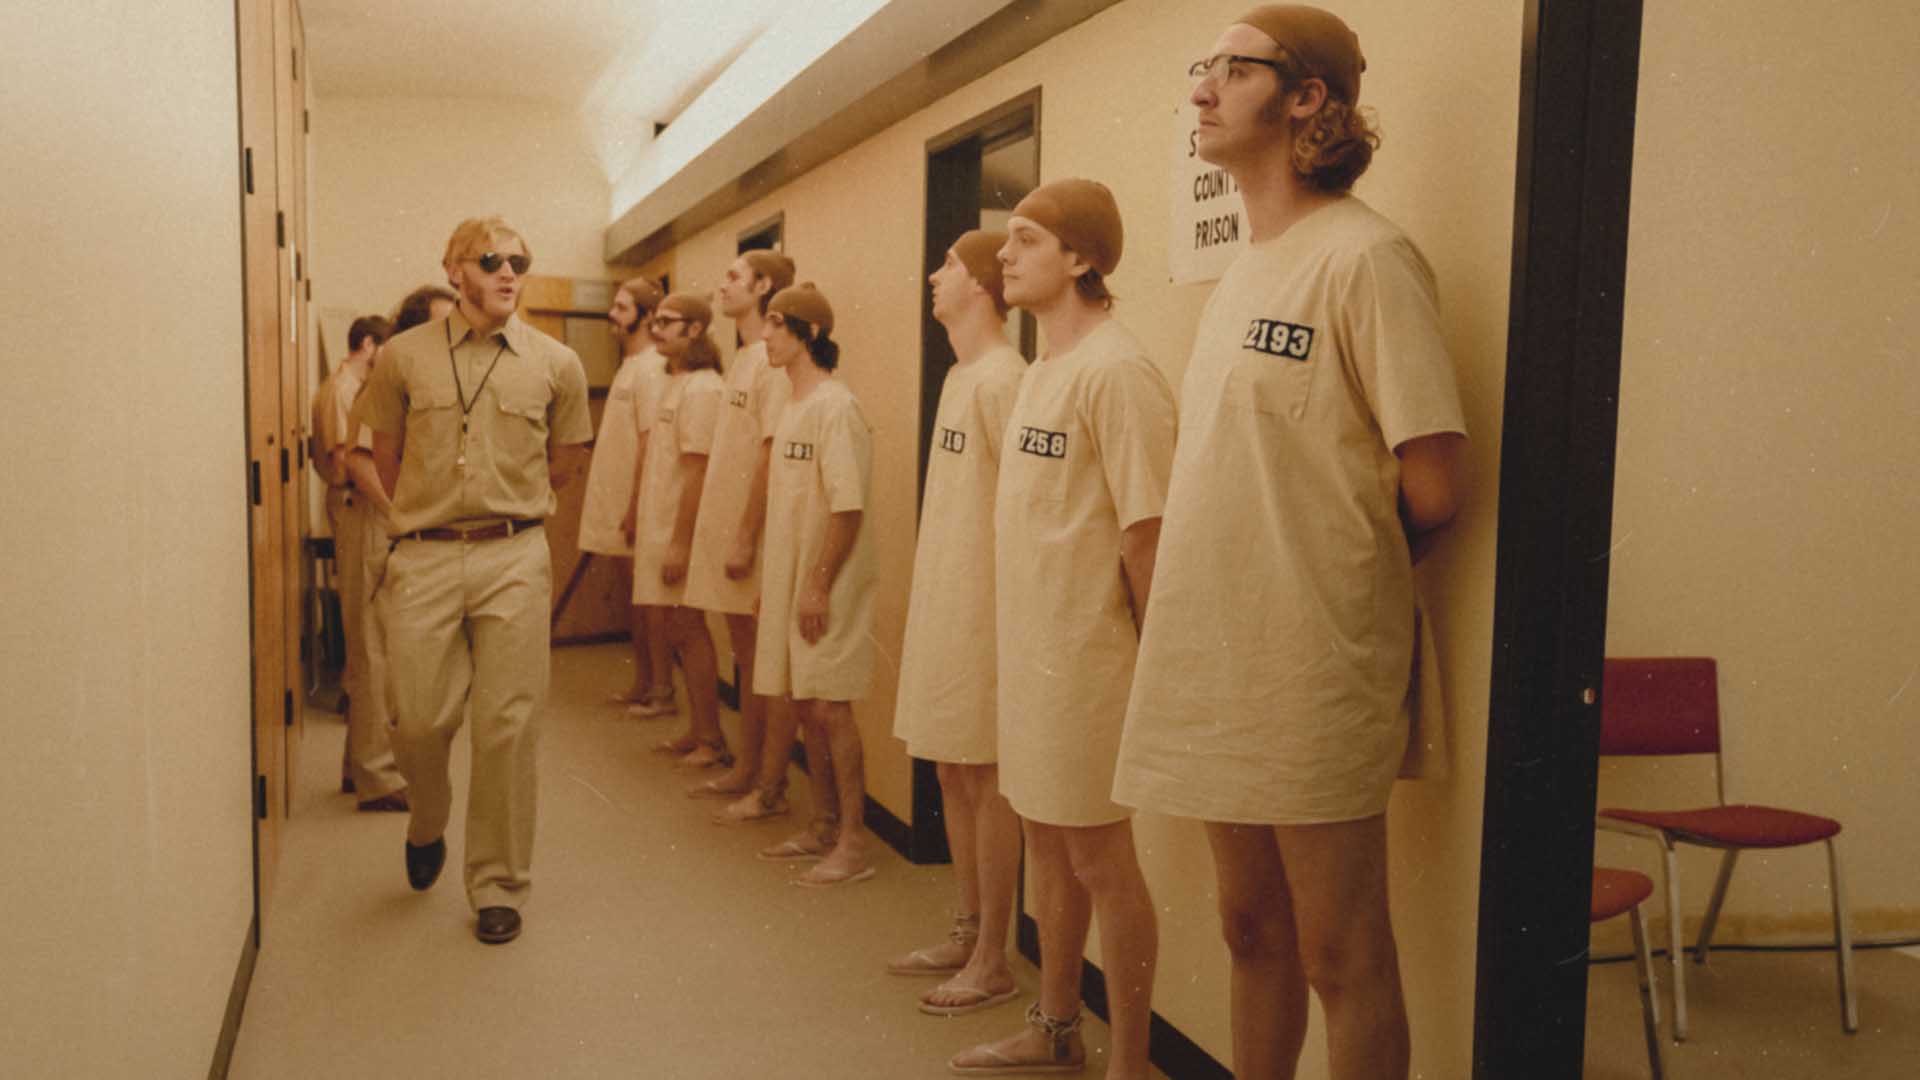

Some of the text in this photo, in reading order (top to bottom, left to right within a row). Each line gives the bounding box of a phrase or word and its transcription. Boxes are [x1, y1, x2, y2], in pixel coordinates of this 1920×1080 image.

[1193, 168, 1239, 202] COUNT
[1194, 212, 1239, 250] PRISON
[1242, 319, 1312, 358] 2193
[1019, 427, 1065, 457] 7258
